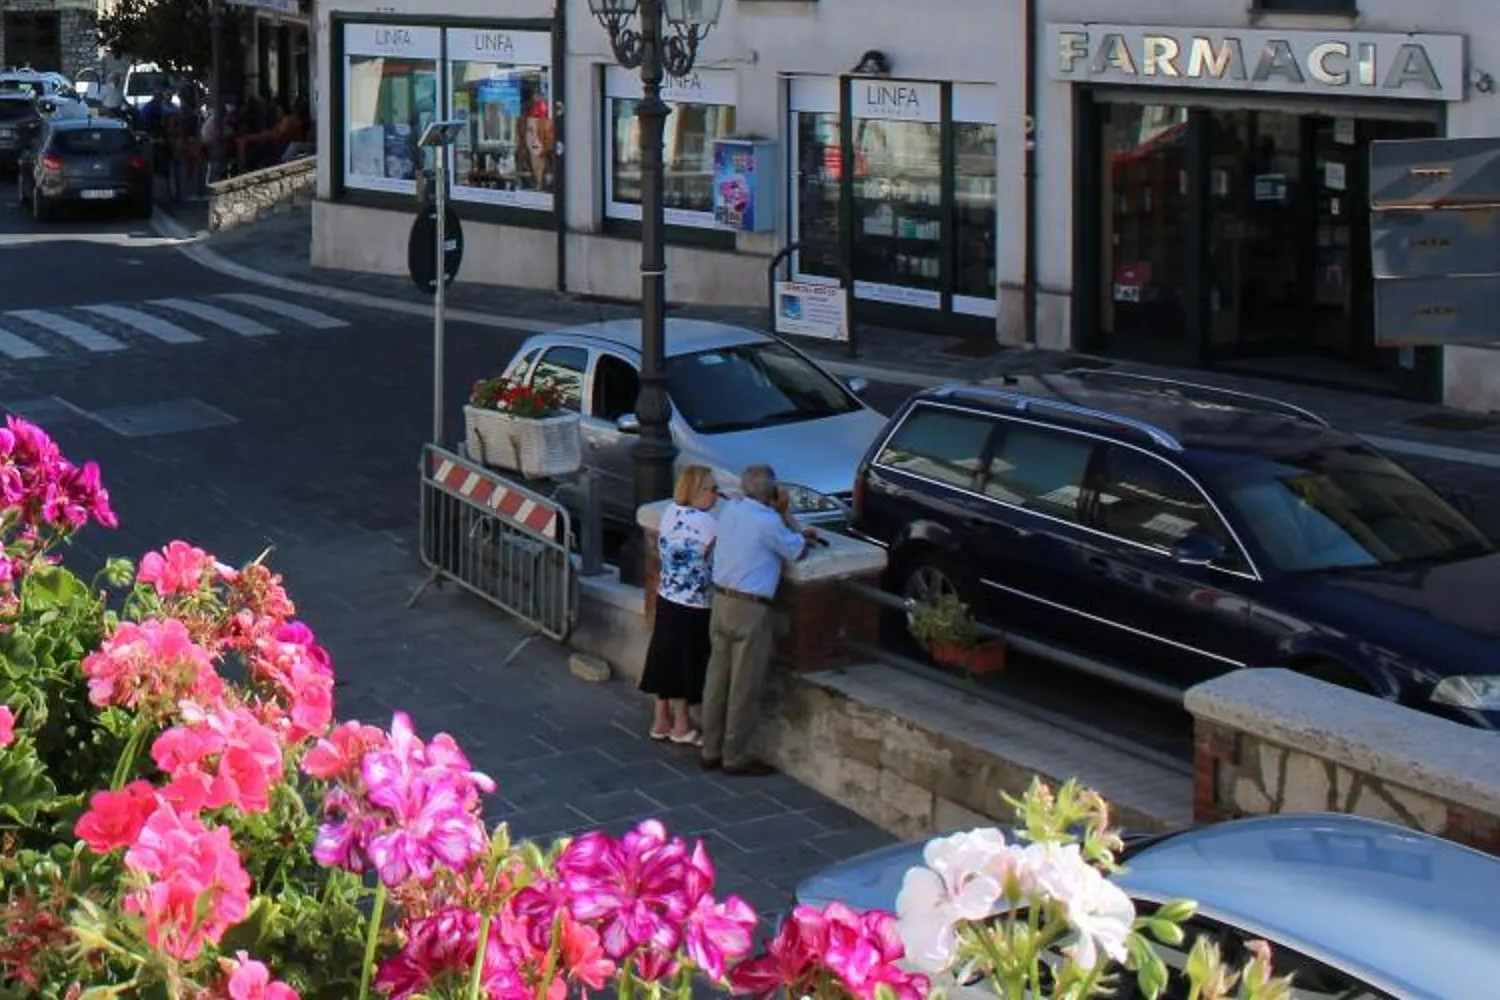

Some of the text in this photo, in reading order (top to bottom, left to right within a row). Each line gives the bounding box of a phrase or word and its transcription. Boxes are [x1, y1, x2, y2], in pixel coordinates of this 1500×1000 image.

[375, 29, 412, 46] LINFA
[475, 33, 514, 53] LINFA
[1057, 31, 1443, 91] FARMACIA
[867, 85, 920, 107] LINFA
